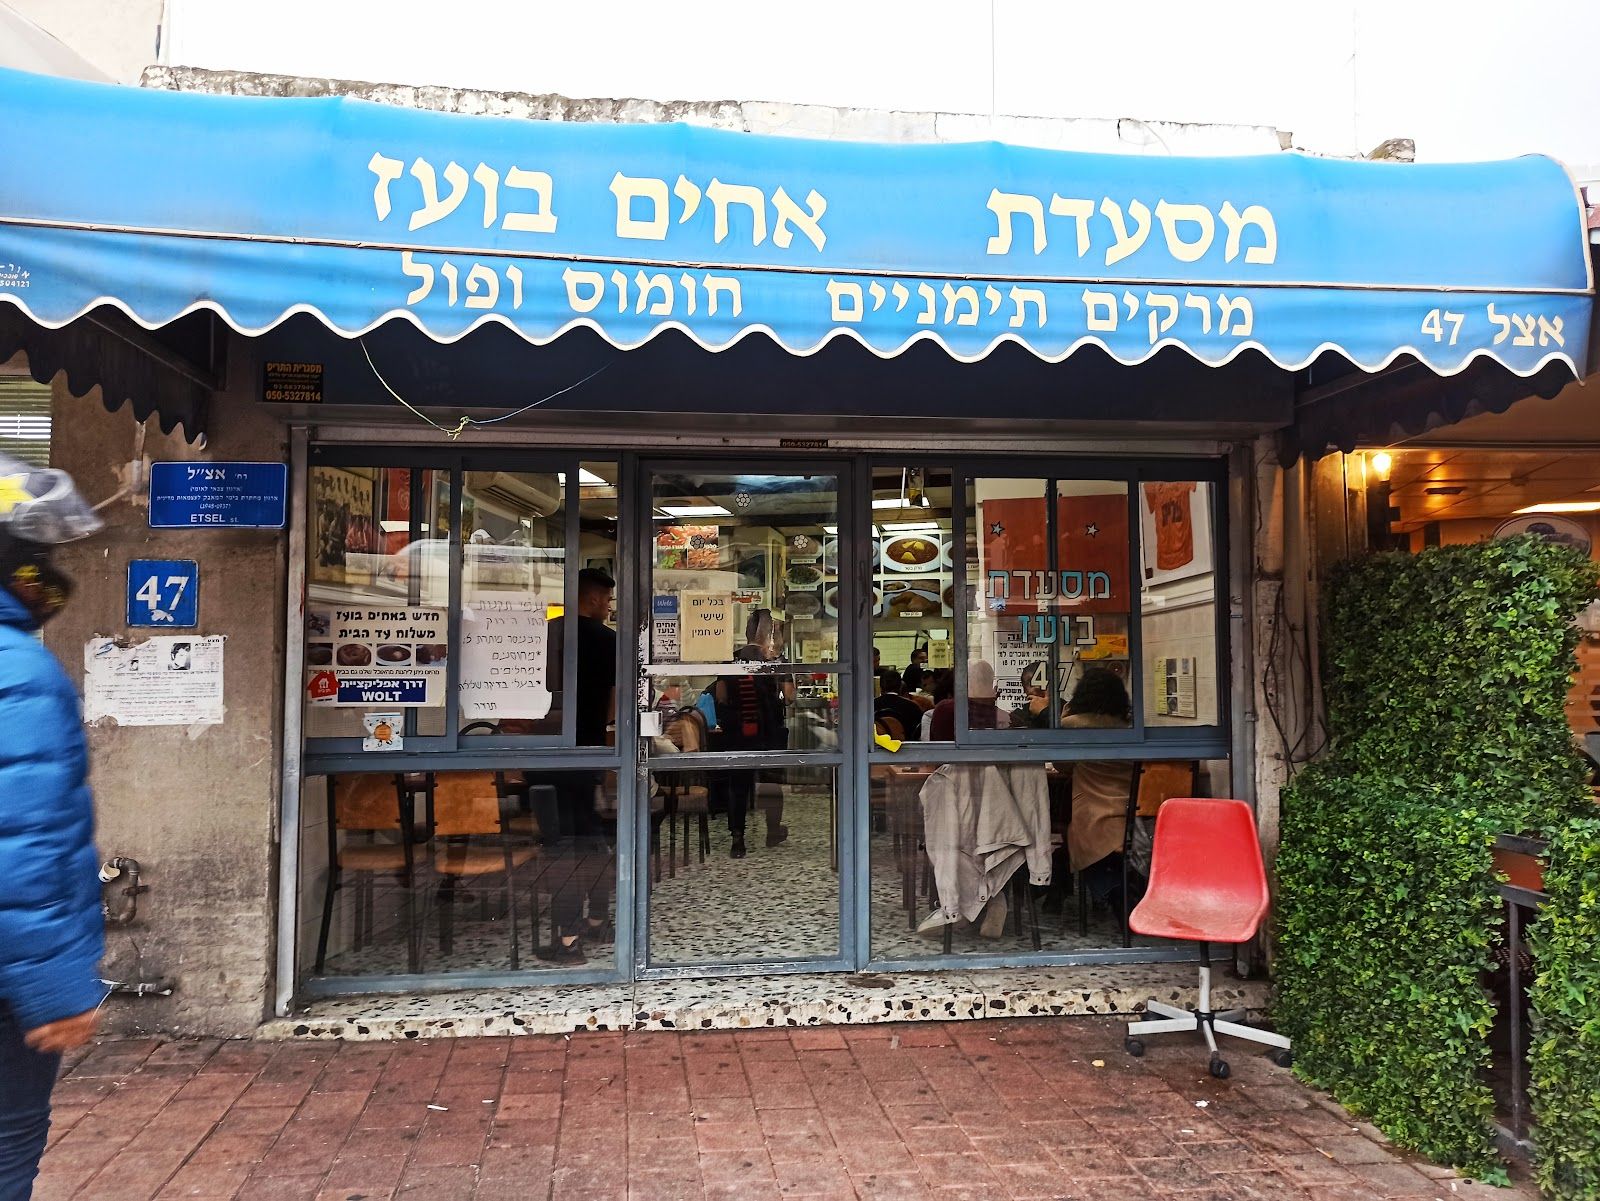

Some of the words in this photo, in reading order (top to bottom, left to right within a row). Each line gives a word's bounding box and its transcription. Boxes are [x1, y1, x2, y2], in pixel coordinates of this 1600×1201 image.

[367, 151, 557, 233] בועז
[609, 170, 828, 253] אחים
[986, 188, 1278, 267] מסעדת
[401, 250, 522, 310] ופול
[563, 266, 743, 318] חומוס
[826, 278, 1048, 329] תימניים
[1082, 288, 1254, 345] מרקים
[1421, 308, 1465, 345] 47
[1486, 302, 1565, 348] אצל
[265, 390, 321, 401] 050-5327814
[190, 513, 226, 523] ETSEL
[985, 569, 1111, 601] מסעדת
[135, 575, 189, 611] 47
[707, 597, 724, 606] בכל
[336, 610, 363, 621] בועז
[368, 610, 407, 621] באחים
[412, 611, 440, 621] חדש
[700, 613, 724, 621] שישי
[338, 629, 370, 638] הבית
[375, 629, 391, 640] עד
[396, 626, 436, 639] משלוח
[692, 628, 711, 638] חמין
[1018, 614, 1098, 646] בועז
[1030, 660, 1074, 692] 47
[340, 679, 400, 690] אפליקציית
[402, 680, 424, 690] דרך
[361, 691, 403, 702] WOLT
